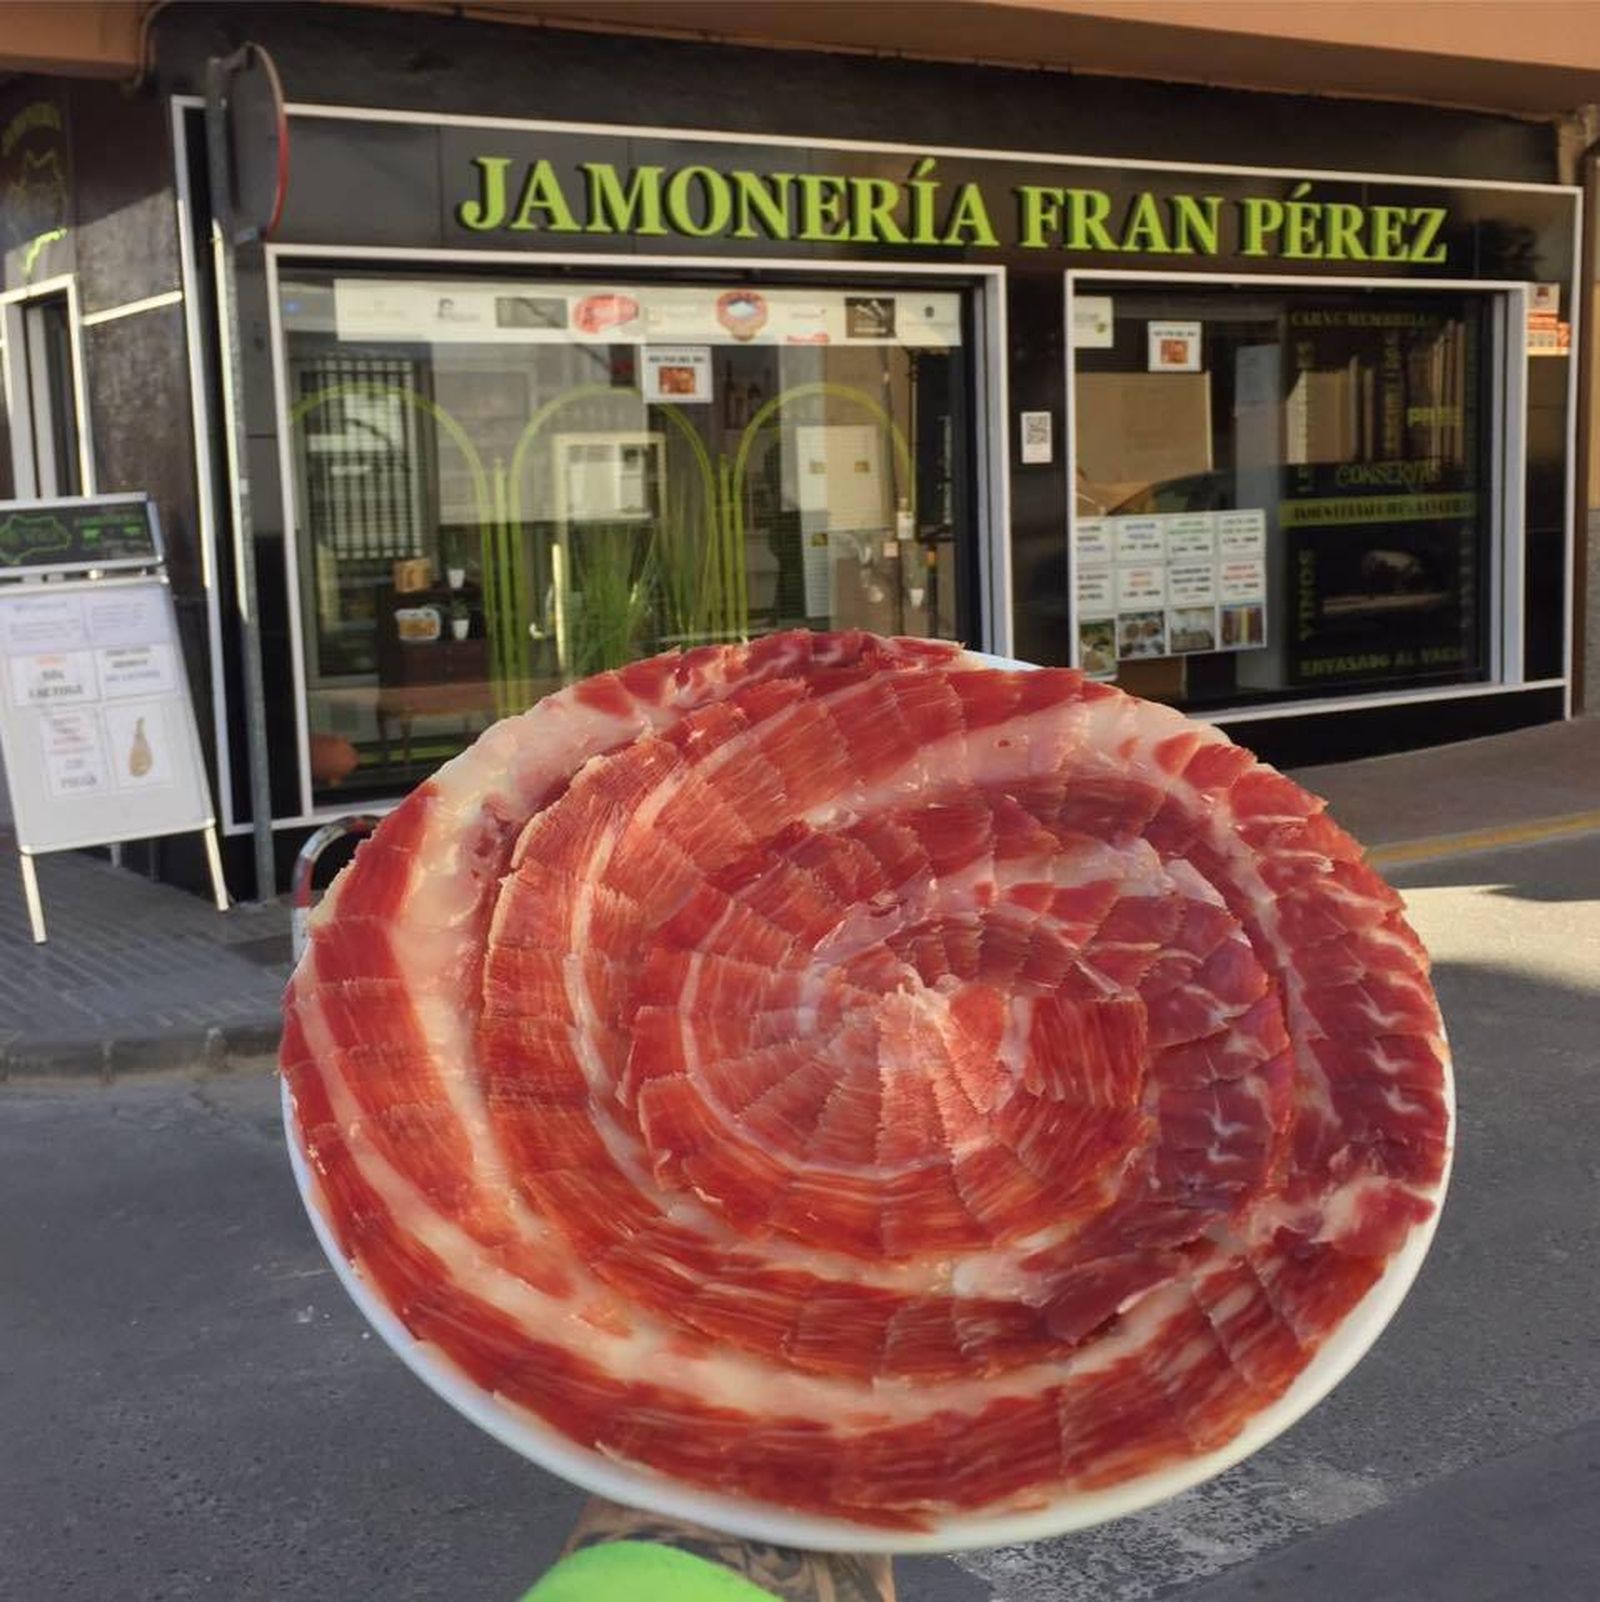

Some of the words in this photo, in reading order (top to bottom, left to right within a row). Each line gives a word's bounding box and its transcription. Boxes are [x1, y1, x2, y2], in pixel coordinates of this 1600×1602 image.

[462, 157, 998, 248] JAMONERÍA
[1022, 185, 1221, 255] FRAN
[1244, 185, 1447, 263] PÉREZ
